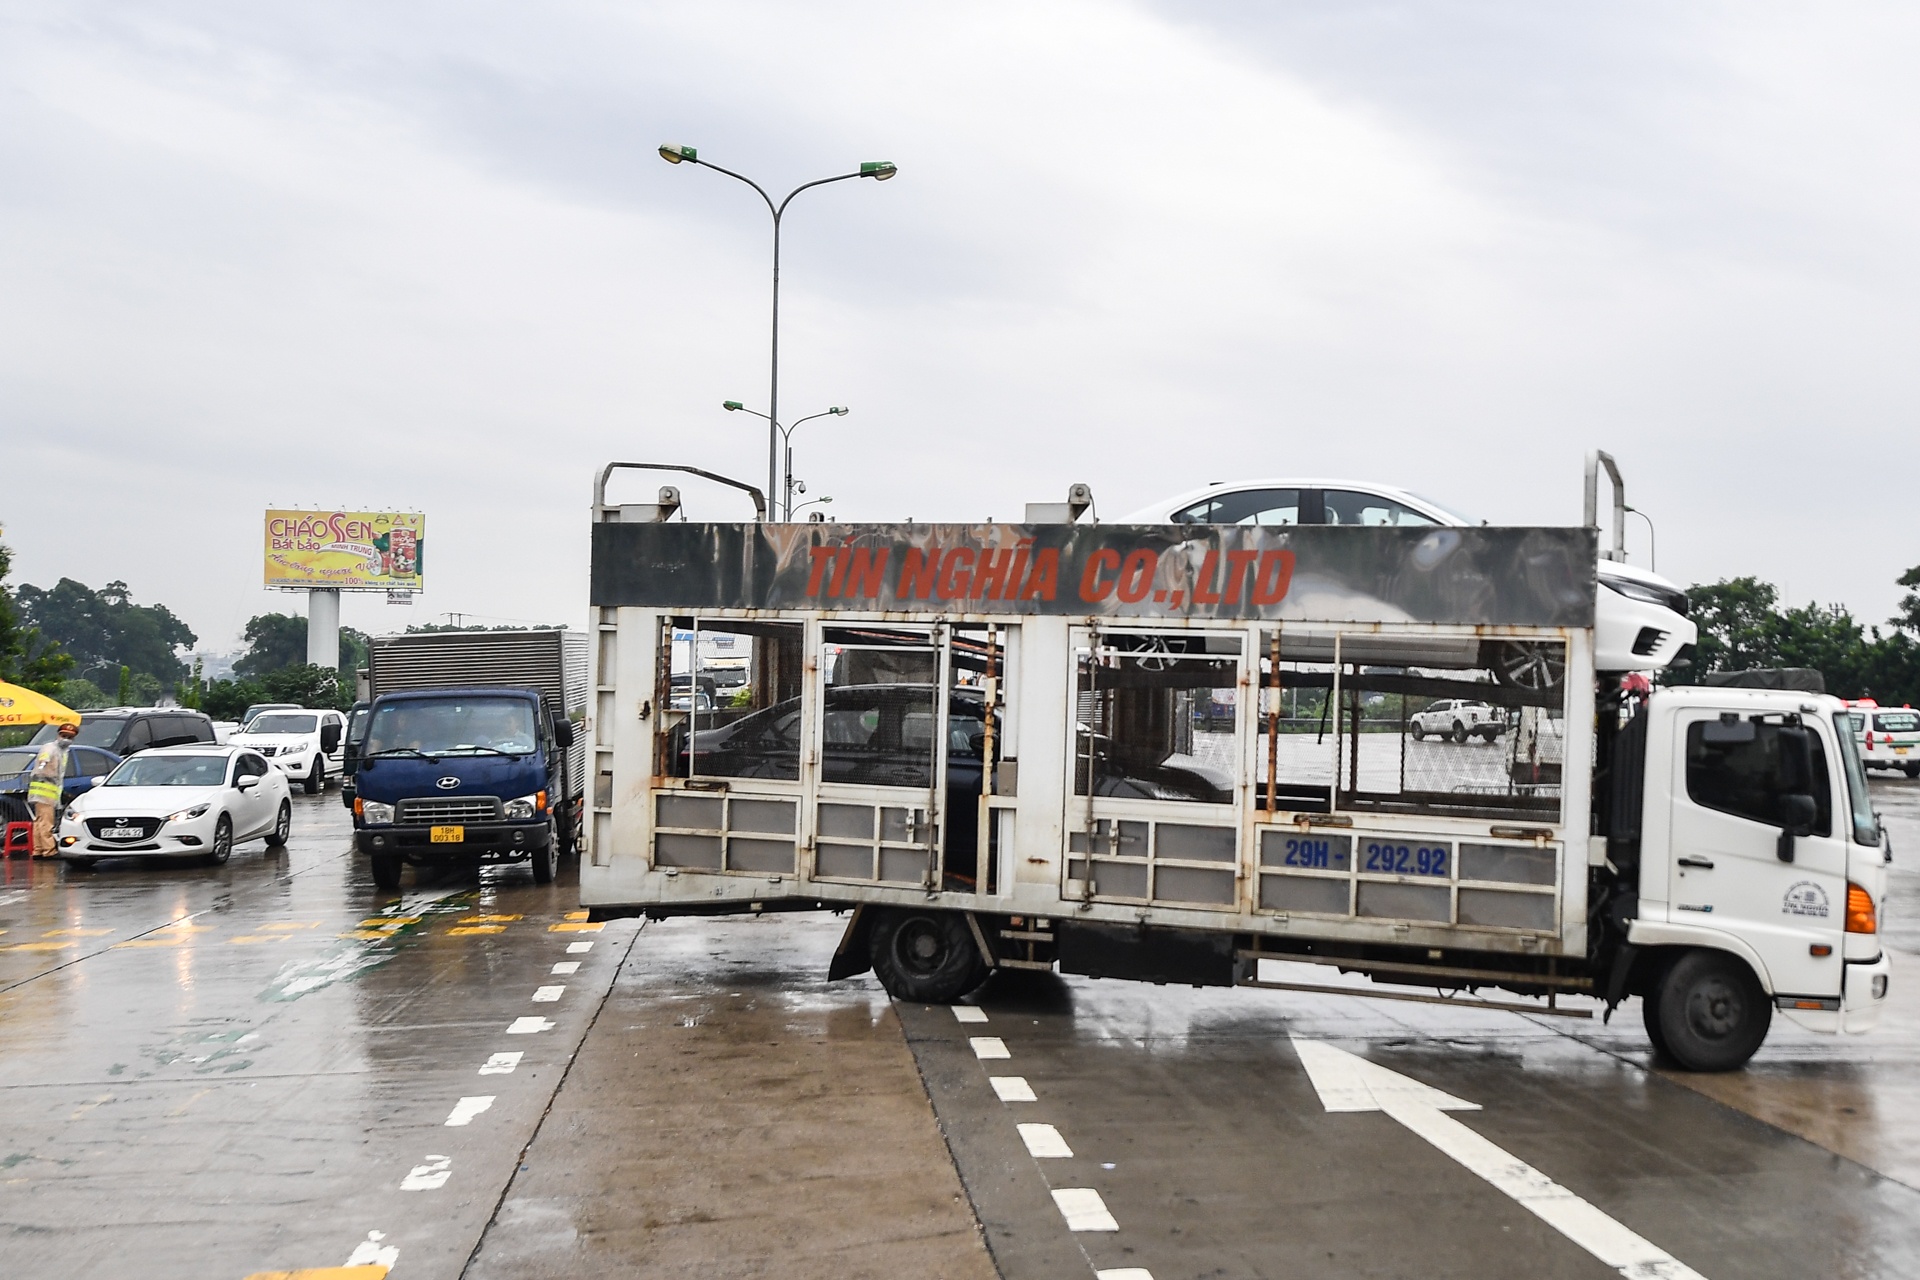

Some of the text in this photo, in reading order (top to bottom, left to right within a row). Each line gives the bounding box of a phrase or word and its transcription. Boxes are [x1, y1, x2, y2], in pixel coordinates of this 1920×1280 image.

[272, 537, 321, 550] Bát bảo
[350, 544, 373, 556] TRUNG
[805, 537, 889, 599] TÍN
[897, 536, 1059, 602] NGHĨA
[440, 827, 455, 835] 18H
[1366, 843, 1446, 875] 292.92
